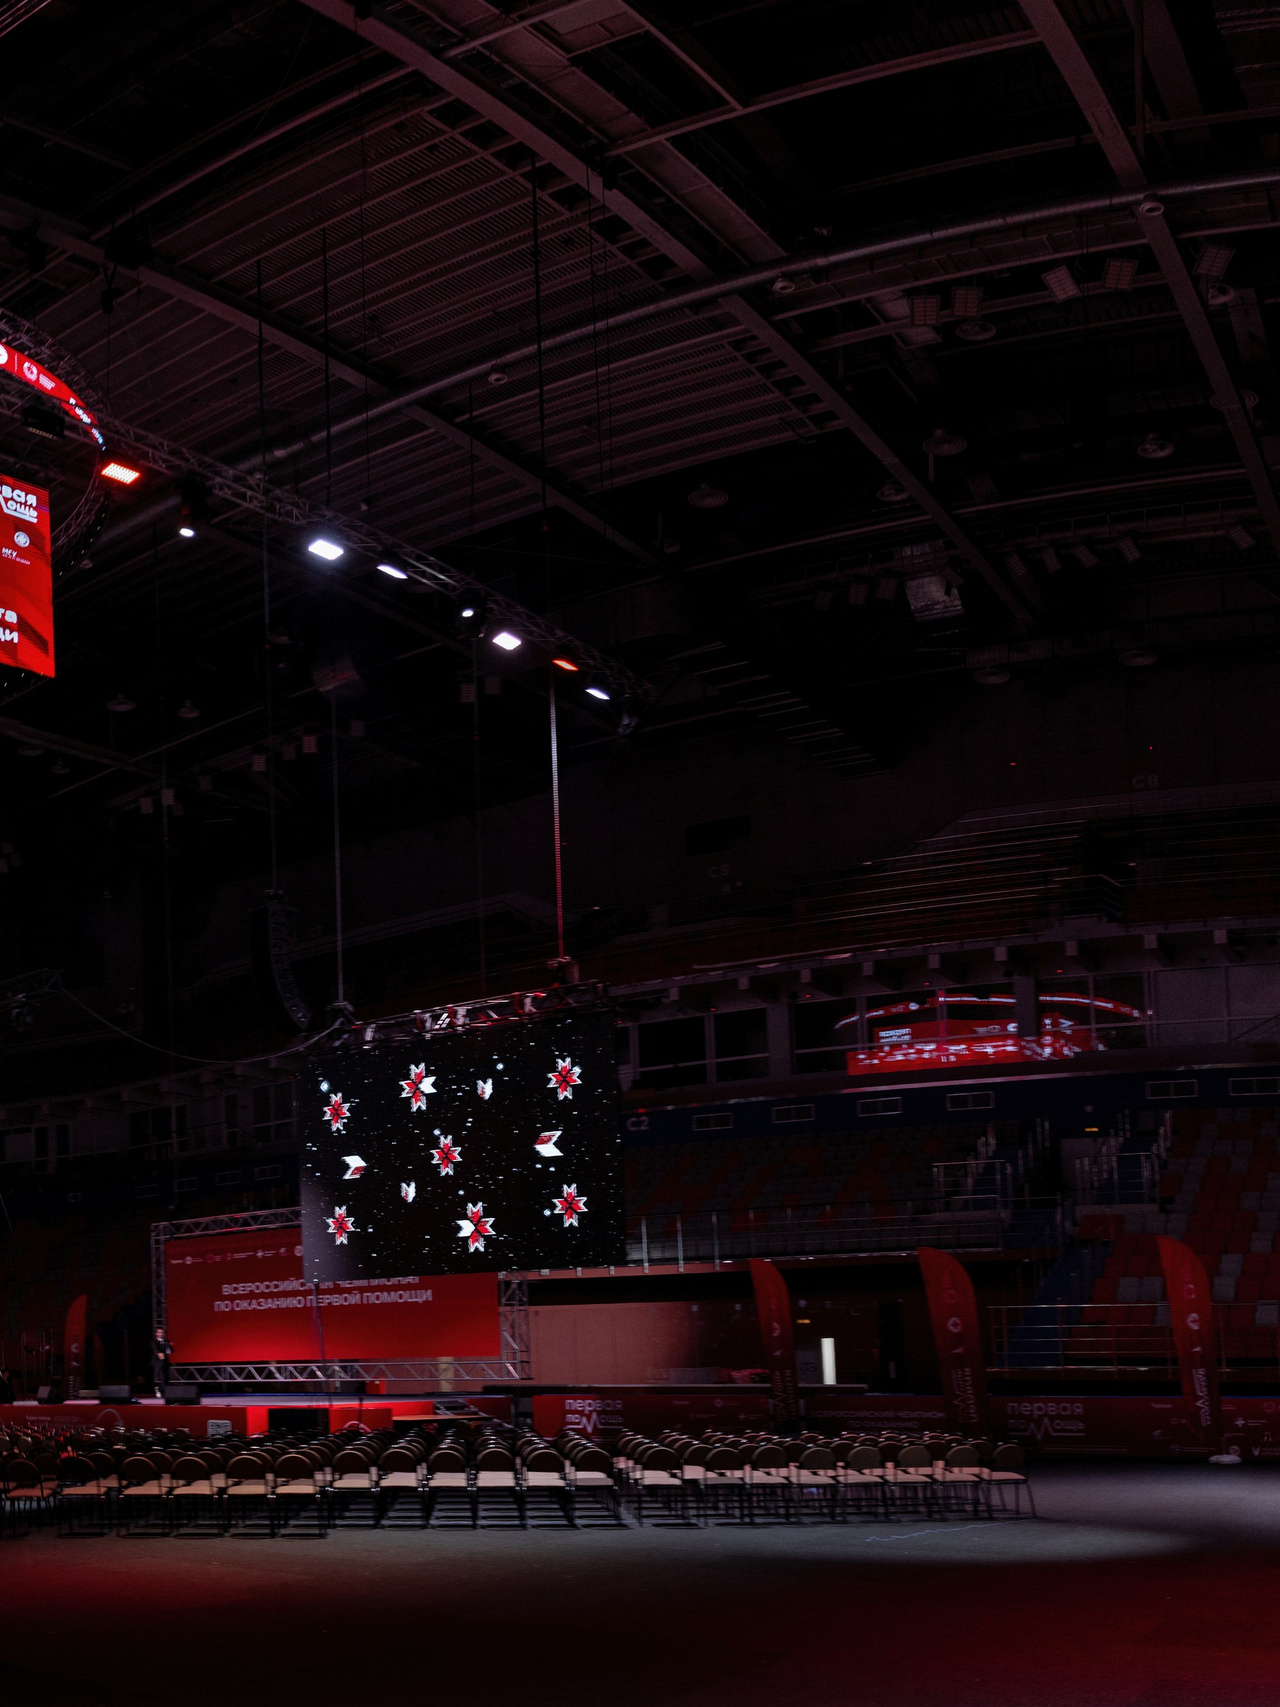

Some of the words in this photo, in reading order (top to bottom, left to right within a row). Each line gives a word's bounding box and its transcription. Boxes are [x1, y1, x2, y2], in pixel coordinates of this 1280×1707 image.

[213, 1300, 232, 1311] ПО
[233, 1296, 304, 1311] ОКАЗАНИЮ
[305, 1291, 362, 1307] ПЕРВОЙ
[363, 1289, 433, 1304] ПОМОЩИ
[565, 1400, 623, 1415] первая
[1006, 1402, 1084, 1419] первая
